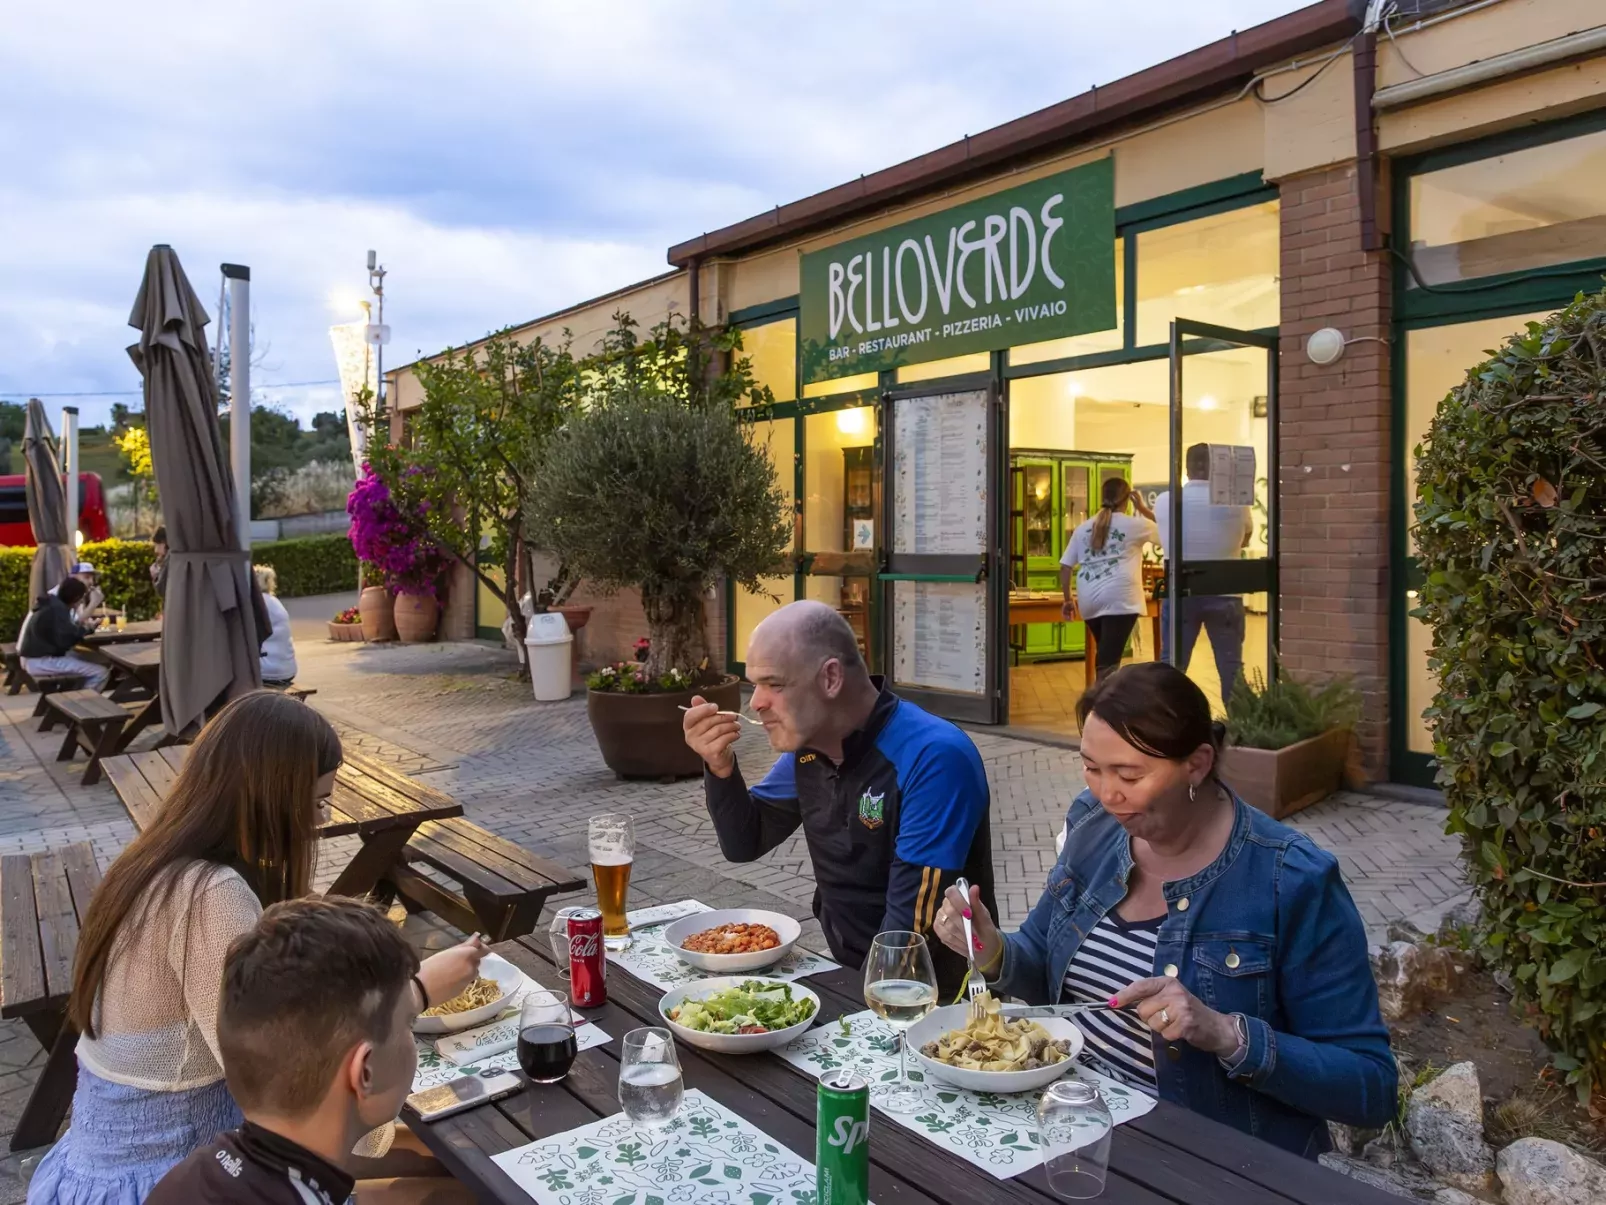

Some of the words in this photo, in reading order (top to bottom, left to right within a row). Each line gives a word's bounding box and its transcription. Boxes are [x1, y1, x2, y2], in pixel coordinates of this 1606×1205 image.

[828, 193, 1065, 340] BELLOVERDE
[829, 346, 850, 361] BAR
[858, 328, 932, 355] RESTAURANT
[943, 313, 1002, 338] PIZZERIA
[1015, 300, 1067, 323] VIVAIO
[569, 932, 599, 957] Cola
[827, 1115, 869, 1155] Sp
